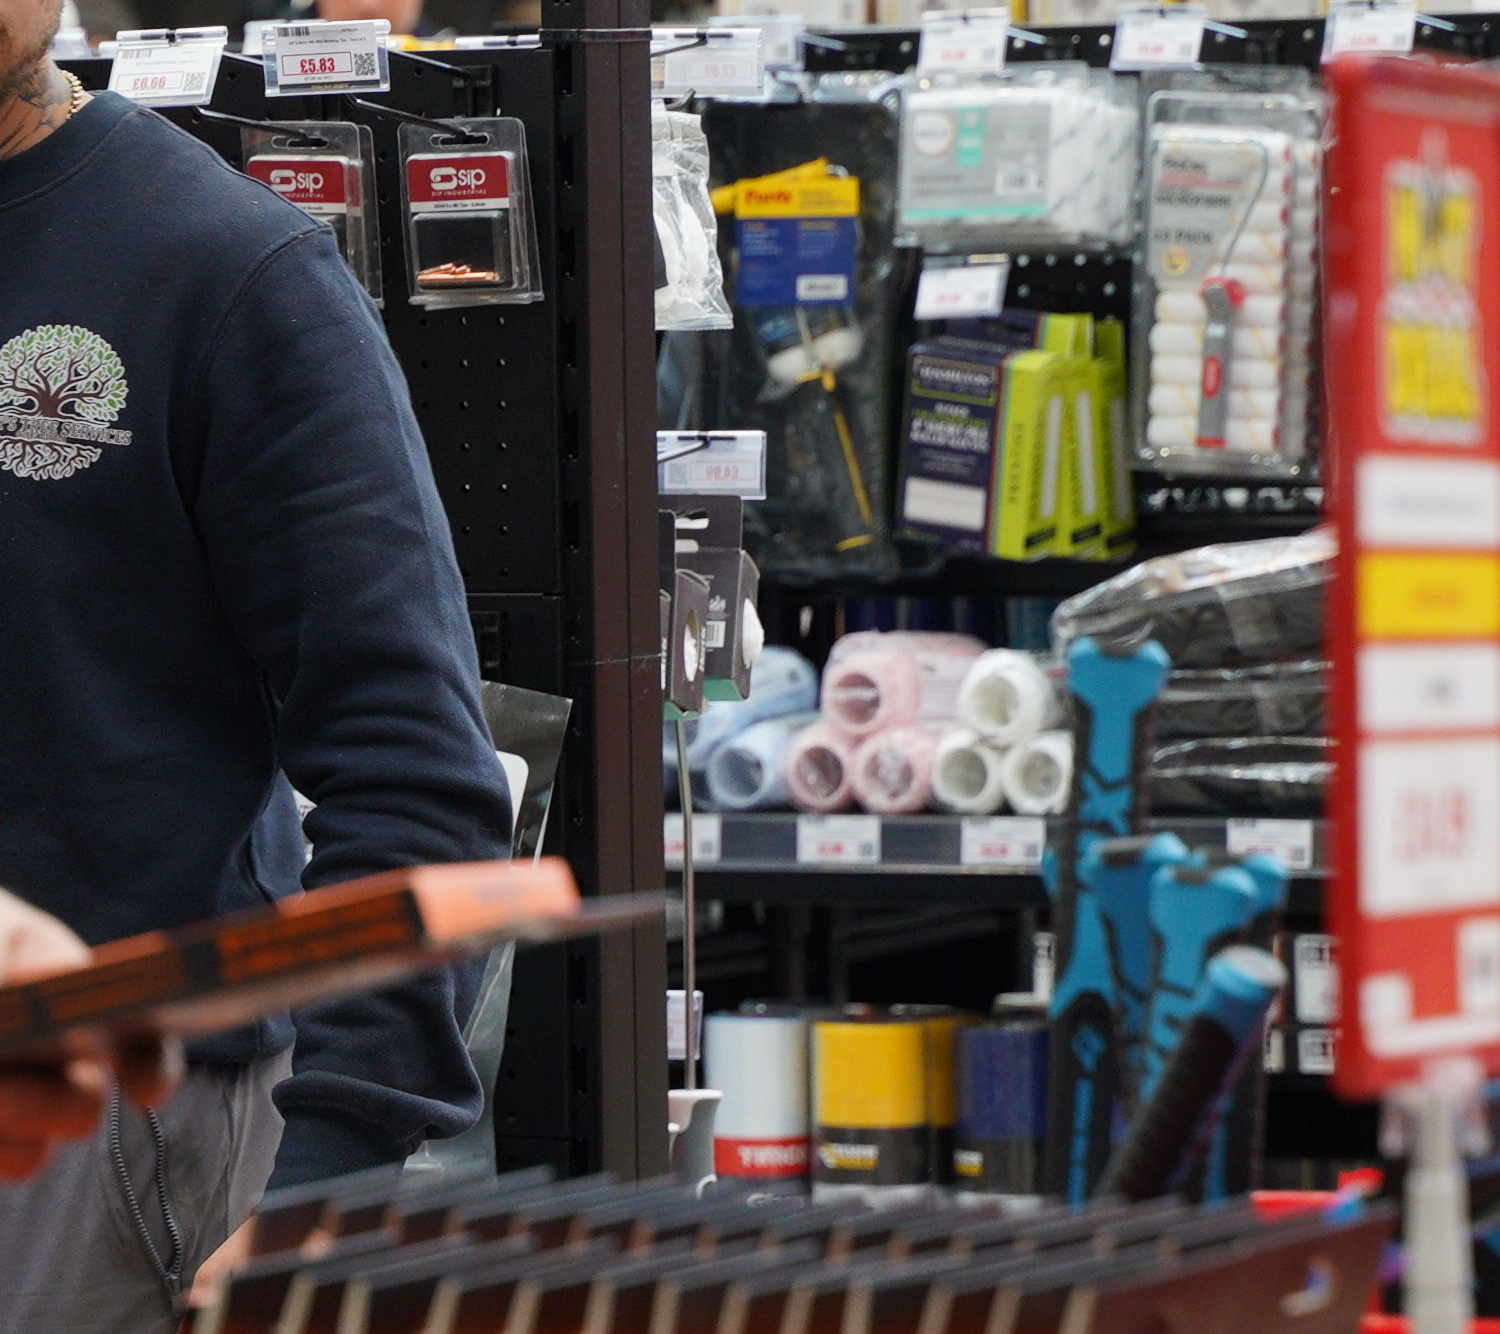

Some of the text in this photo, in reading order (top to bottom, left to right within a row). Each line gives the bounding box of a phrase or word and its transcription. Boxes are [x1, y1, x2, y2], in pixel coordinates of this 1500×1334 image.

[299, 57, 336, 74] £5.83
[19, 417, 60, 437] TREE
[60, 421, 133, 446] SERVICES
